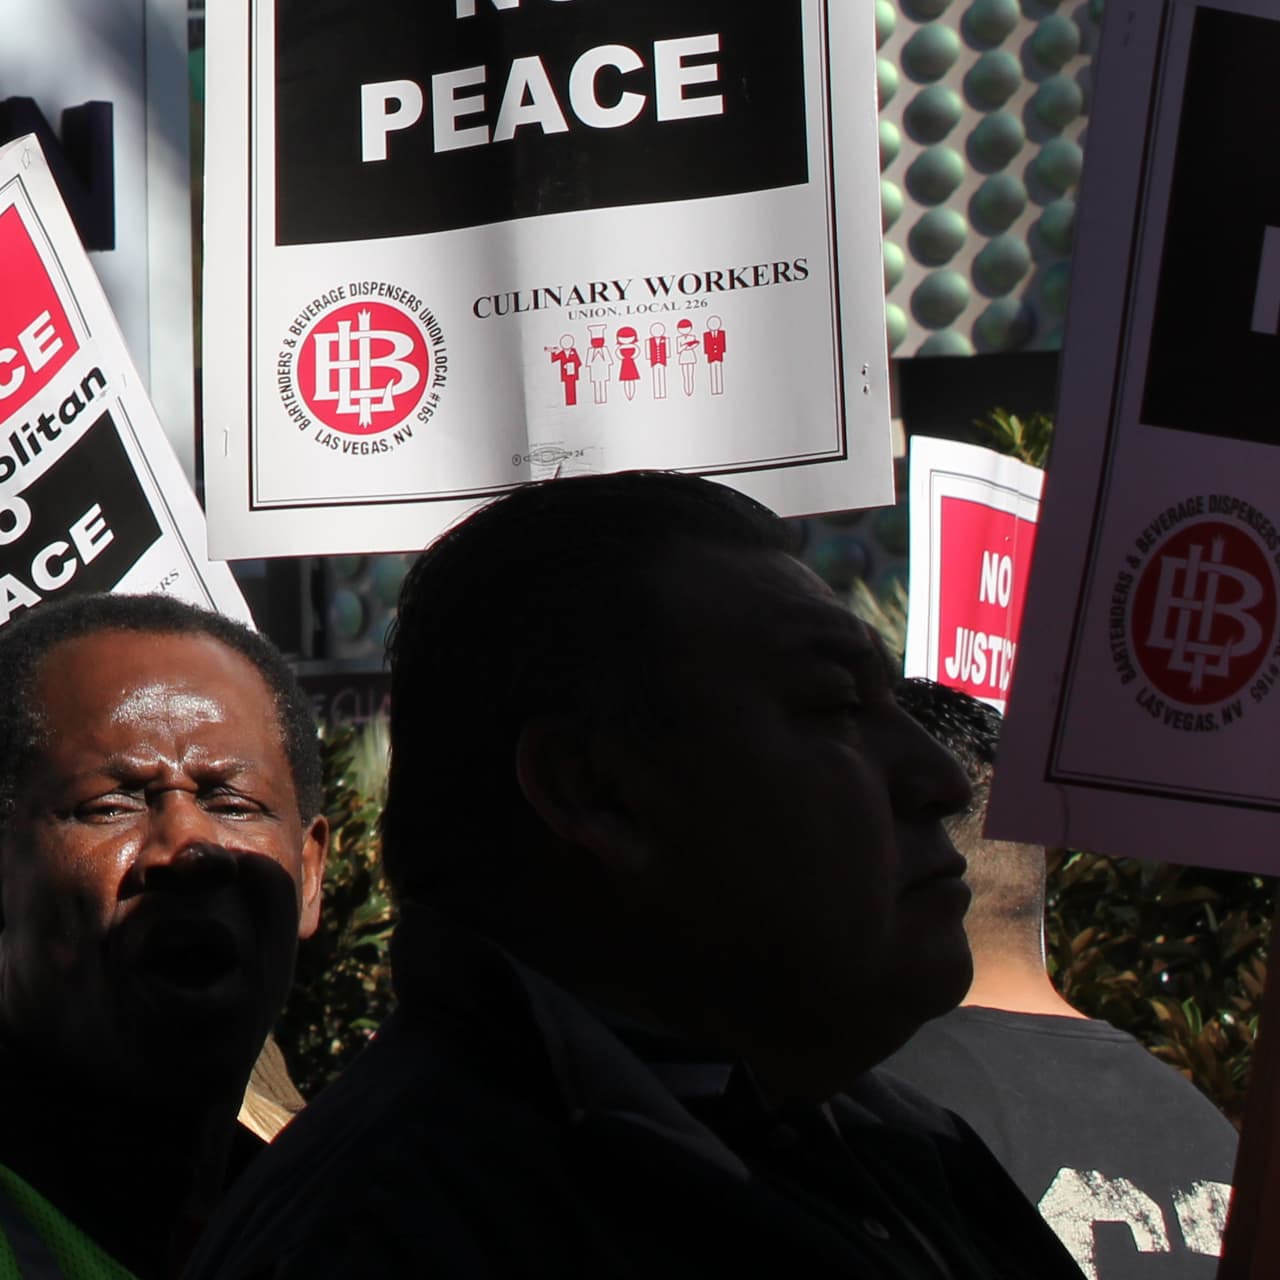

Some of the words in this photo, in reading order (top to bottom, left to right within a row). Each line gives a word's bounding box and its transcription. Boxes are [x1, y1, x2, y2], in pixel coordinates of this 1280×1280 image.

[360, 33, 724, 162] PEACE
[349, 281, 422, 313] DISPENSERS
[473, 279, 633, 319] CULINARY
[642, 258, 809, 298] WORKERS
[626, 301, 680, 315] LOCAL
[685, 298, 708, 310] 226
[289, 286, 346, 336] BEVERAGE
[418, 307, 444, 346] UNION
[284, 338, 296, 348] &
[432, 348, 447, 388] LOCAL
[277, 351, 311, 431] BARTENDERS
[416, 392, 440, 424] #165
[315, 429, 341, 450] LAS
[393, 424, 413, 445] NV
[1135, 496, 1205, 553] BEVERAGE
[980, 550, 1011, 608] NO
[945, 626, 1016, 692] JUSTIC
[1135, 687, 1164, 719] LAS
[1222, 700, 1242, 725] NV
